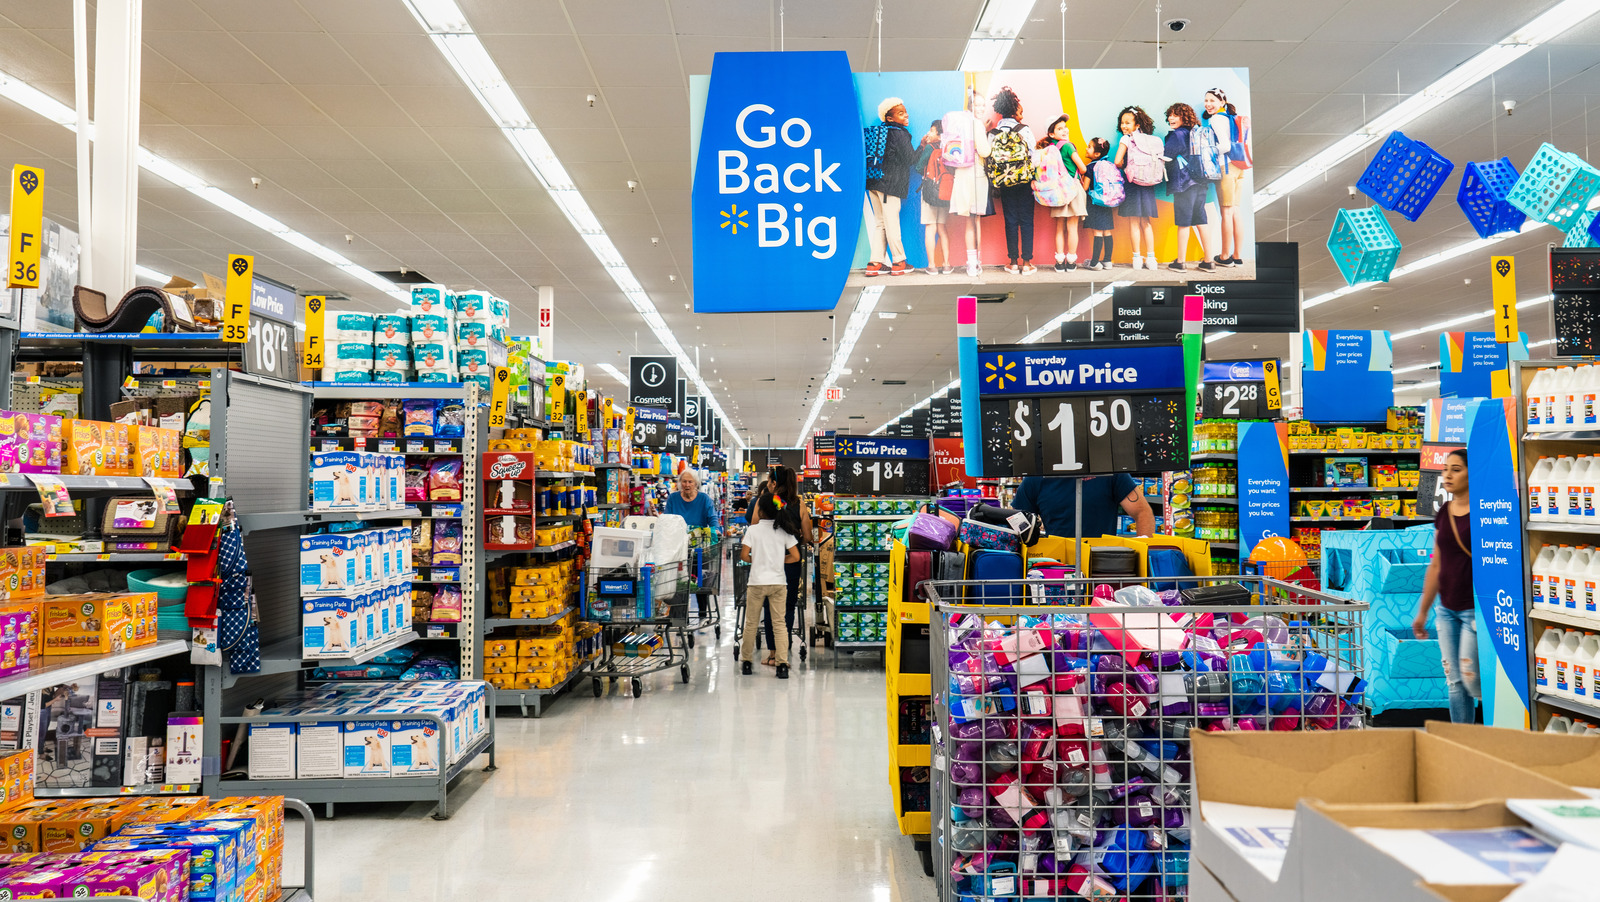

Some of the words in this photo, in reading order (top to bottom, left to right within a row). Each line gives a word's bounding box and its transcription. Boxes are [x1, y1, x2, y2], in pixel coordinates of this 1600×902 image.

[735, 103, 812, 149] Go
[718, 149, 842, 195] Back
[757, 203, 838, 259] Big
[20, 233, 33, 252] F
[14, 261, 37, 282] 36
[1195, 284, 1225, 296] Spices
[1152, 292, 1164, 300] 25
[253, 290, 267, 309] Low
[267, 296, 284, 315] Price
[1202, 300, 1228, 311] aking
[232, 304, 243, 319] F
[1119, 321, 1145, 330] Candy
[1202, 315, 1238, 326] easonal
[226, 325, 246, 340] 35
[1504, 325, 1509, 338] 1
[310, 336, 318, 348] F
[306, 354, 321, 365] 34
[1025, 356, 1066, 366] Everyday
[1025, 365, 1075, 386] Low
[1079, 362, 1138, 384] Price
[827, 389, 840, 400] EXIT
[1269, 388, 1277, 396] G
[634, 396, 672, 404] Cosmetics
[1269, 399, 1280, 407] 24
[495, 401, 502, 411] F
[555, 402, 560, 410] F
[491, 415, 503, 425] 33
[552, 412, 562, 420] 32
[640, 411, 652, 419] Low
[856, 445, 879, 455] Low
[880, 445, 907, 455] Price
[346, 463, 357, 472] 100
[491, 461, 526, 478] Squeeze
[1248, 479, 1280, 488] Everything
[1480, 499, 1512, 511] Everything
[1480, 517, 1492, 526] you
[1493, 515, 1509, 525] want.
[1481, 538, 1494, 548] Low
[1495, 539, 1513, 551] prices
[332, 546, 343, 556] 100
[1482, 556, 1494, 565] you
[1495, 554, 1508, 564] love.
[1497, 589, 1512, 607] Go
[336, 608, 348, 618] 100
[1494, 606, 1519, 625] Back
[1503, 627, 1520, 651] Big
[26, 712, 34, 737] Playset
[377, 728, 388, 737] 100
[423, 727, 434, 736] 100
[76, 888, 86, 897] 32
